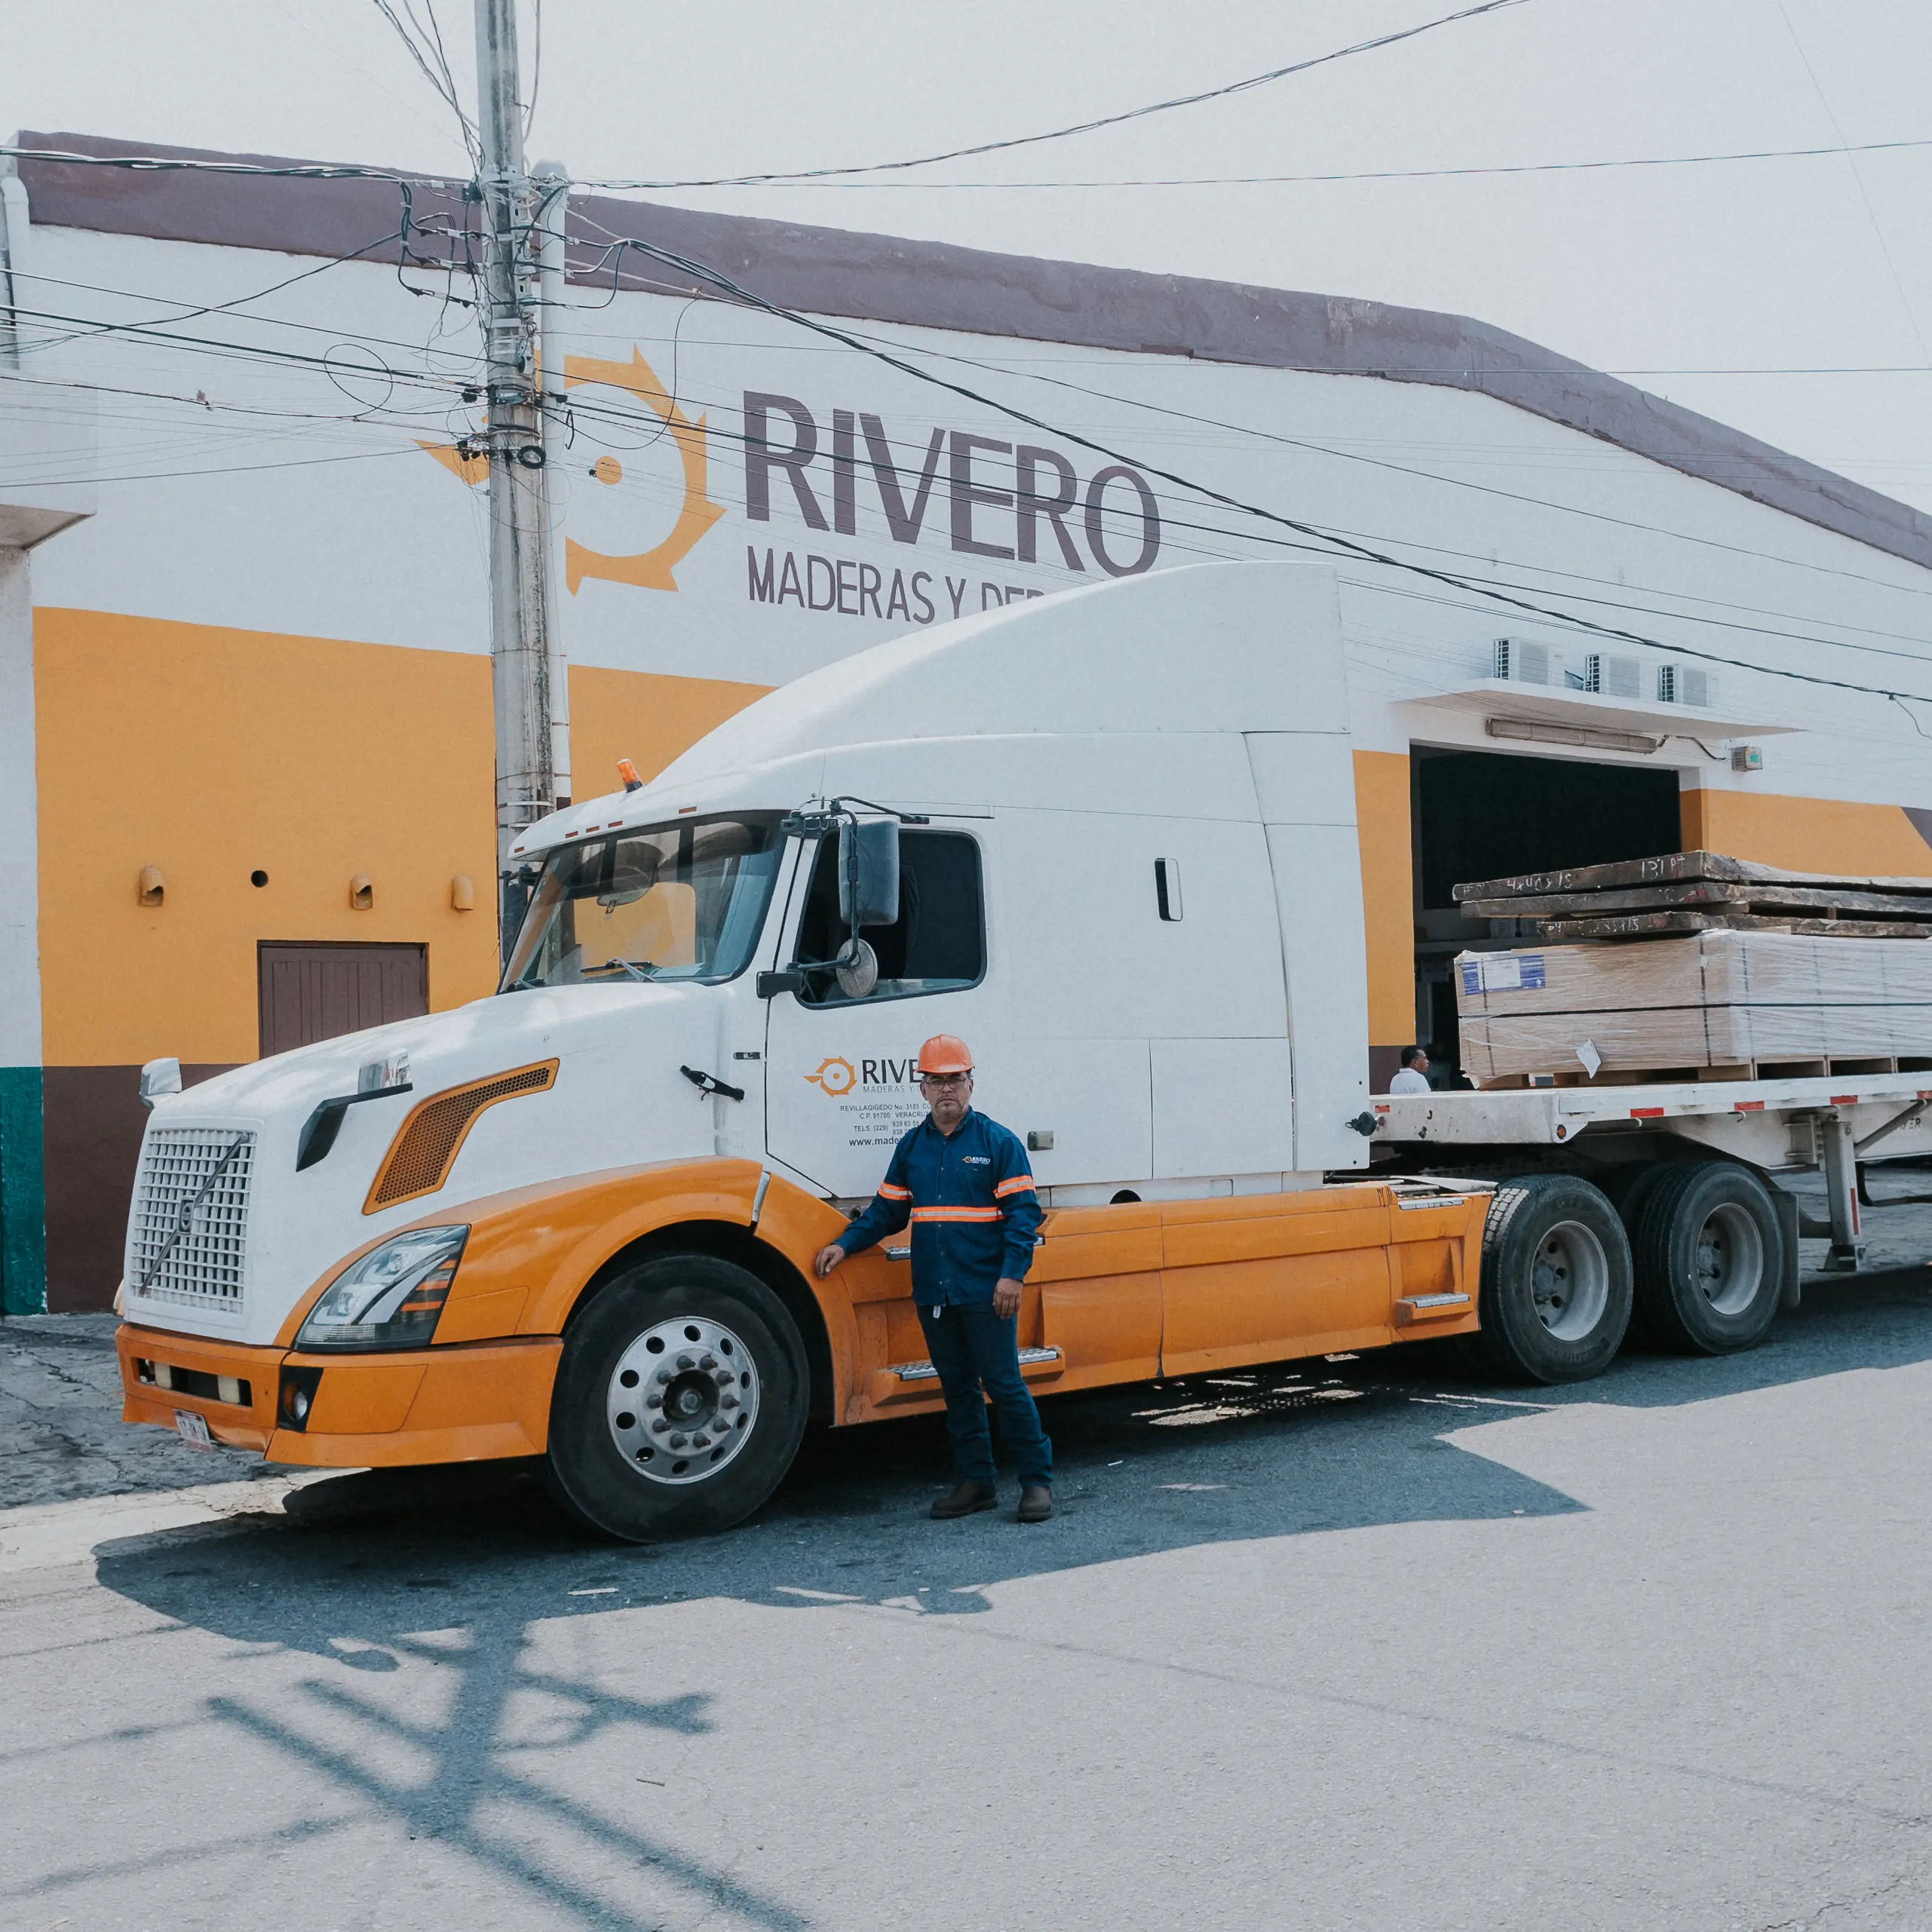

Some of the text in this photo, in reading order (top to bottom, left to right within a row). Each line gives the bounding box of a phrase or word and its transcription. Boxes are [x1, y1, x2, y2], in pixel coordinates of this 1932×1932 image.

[744, 391, 1160, 578] RIVERO
[747, 545, 935, 624] MADERAS
[945, 576, 967, 619] Y
[862, 1059, 922, 1084] RIVE
[849, 1136, 903, 1146] www.made
